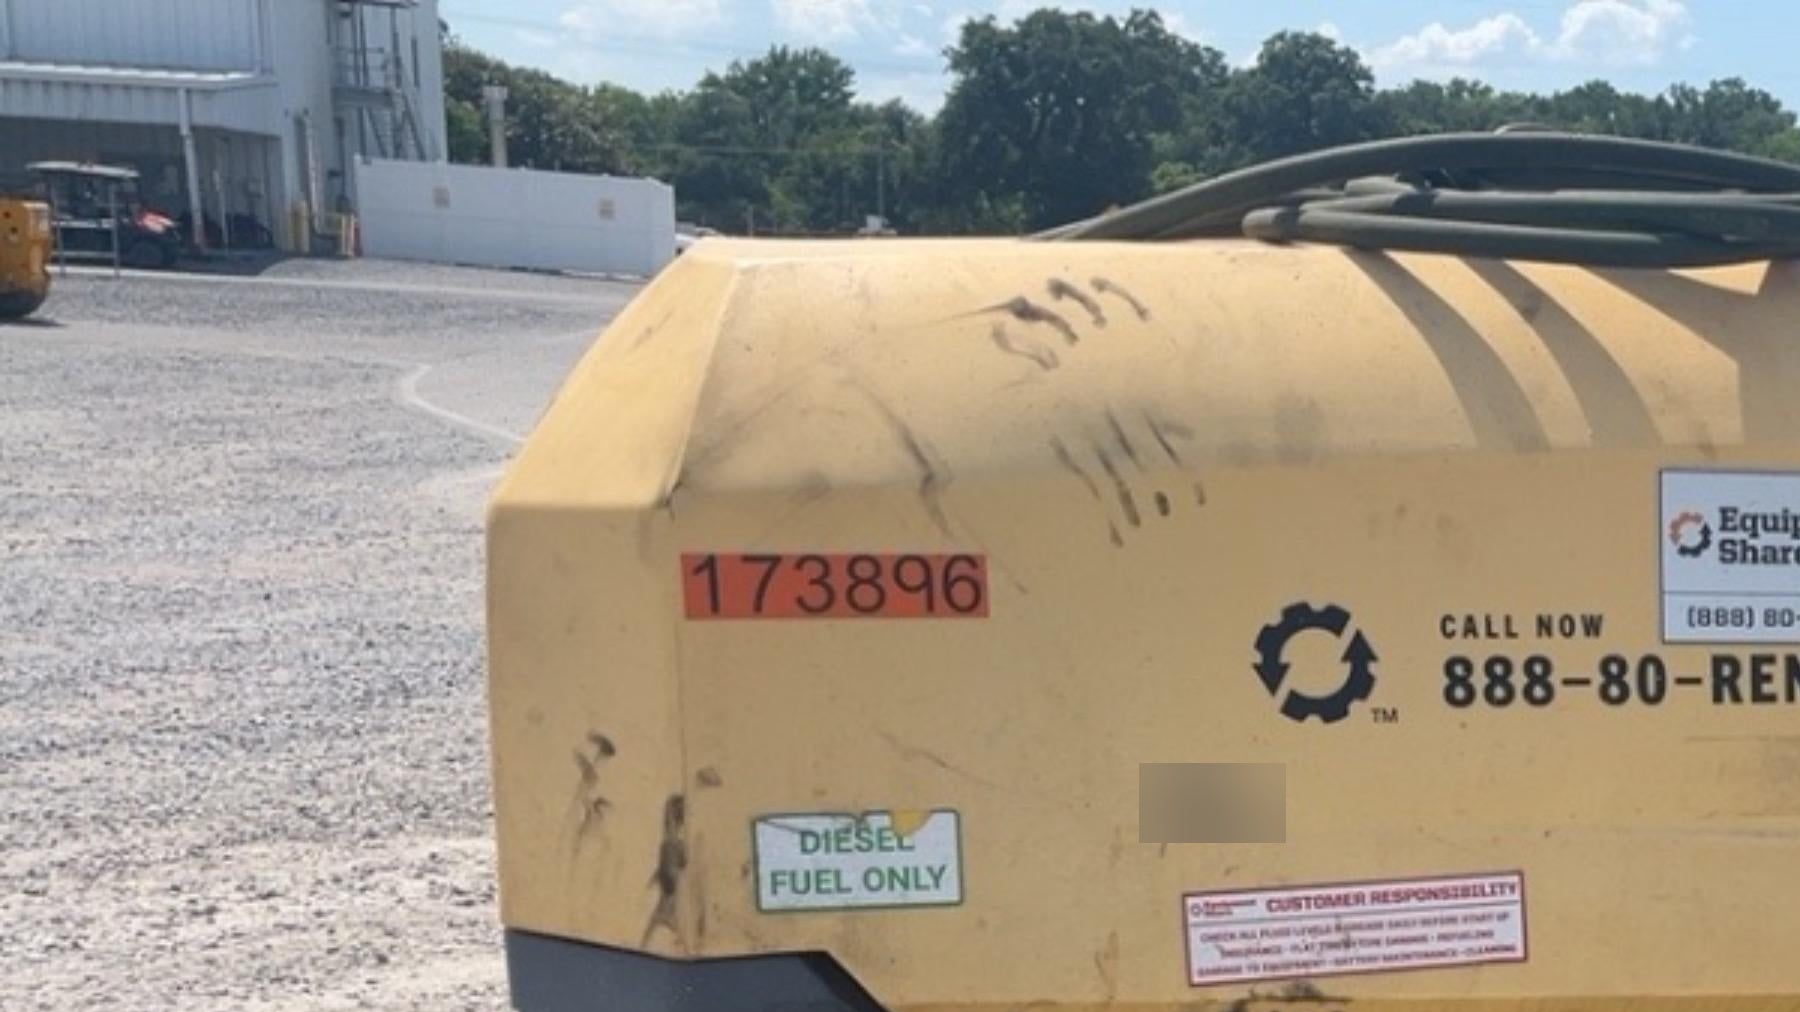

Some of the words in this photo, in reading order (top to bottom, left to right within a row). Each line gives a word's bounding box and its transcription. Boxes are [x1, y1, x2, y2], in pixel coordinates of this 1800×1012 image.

[691, 554, 983, 614] 173896
[1439, 613, 1519, 639] CALL
[1536, 613, 1604, 639] NOW
[1687, 605, 1755, 629] (888)
[800, 826, 916, 856] DIESEL
[770, 869, 853, 896] FUEL
[862, 864, 947, 893] ONLY
[1265, 892, 1366, 914] CUSTOMER
[1369, 882, 1517, 906] RESPONSIBILITY
